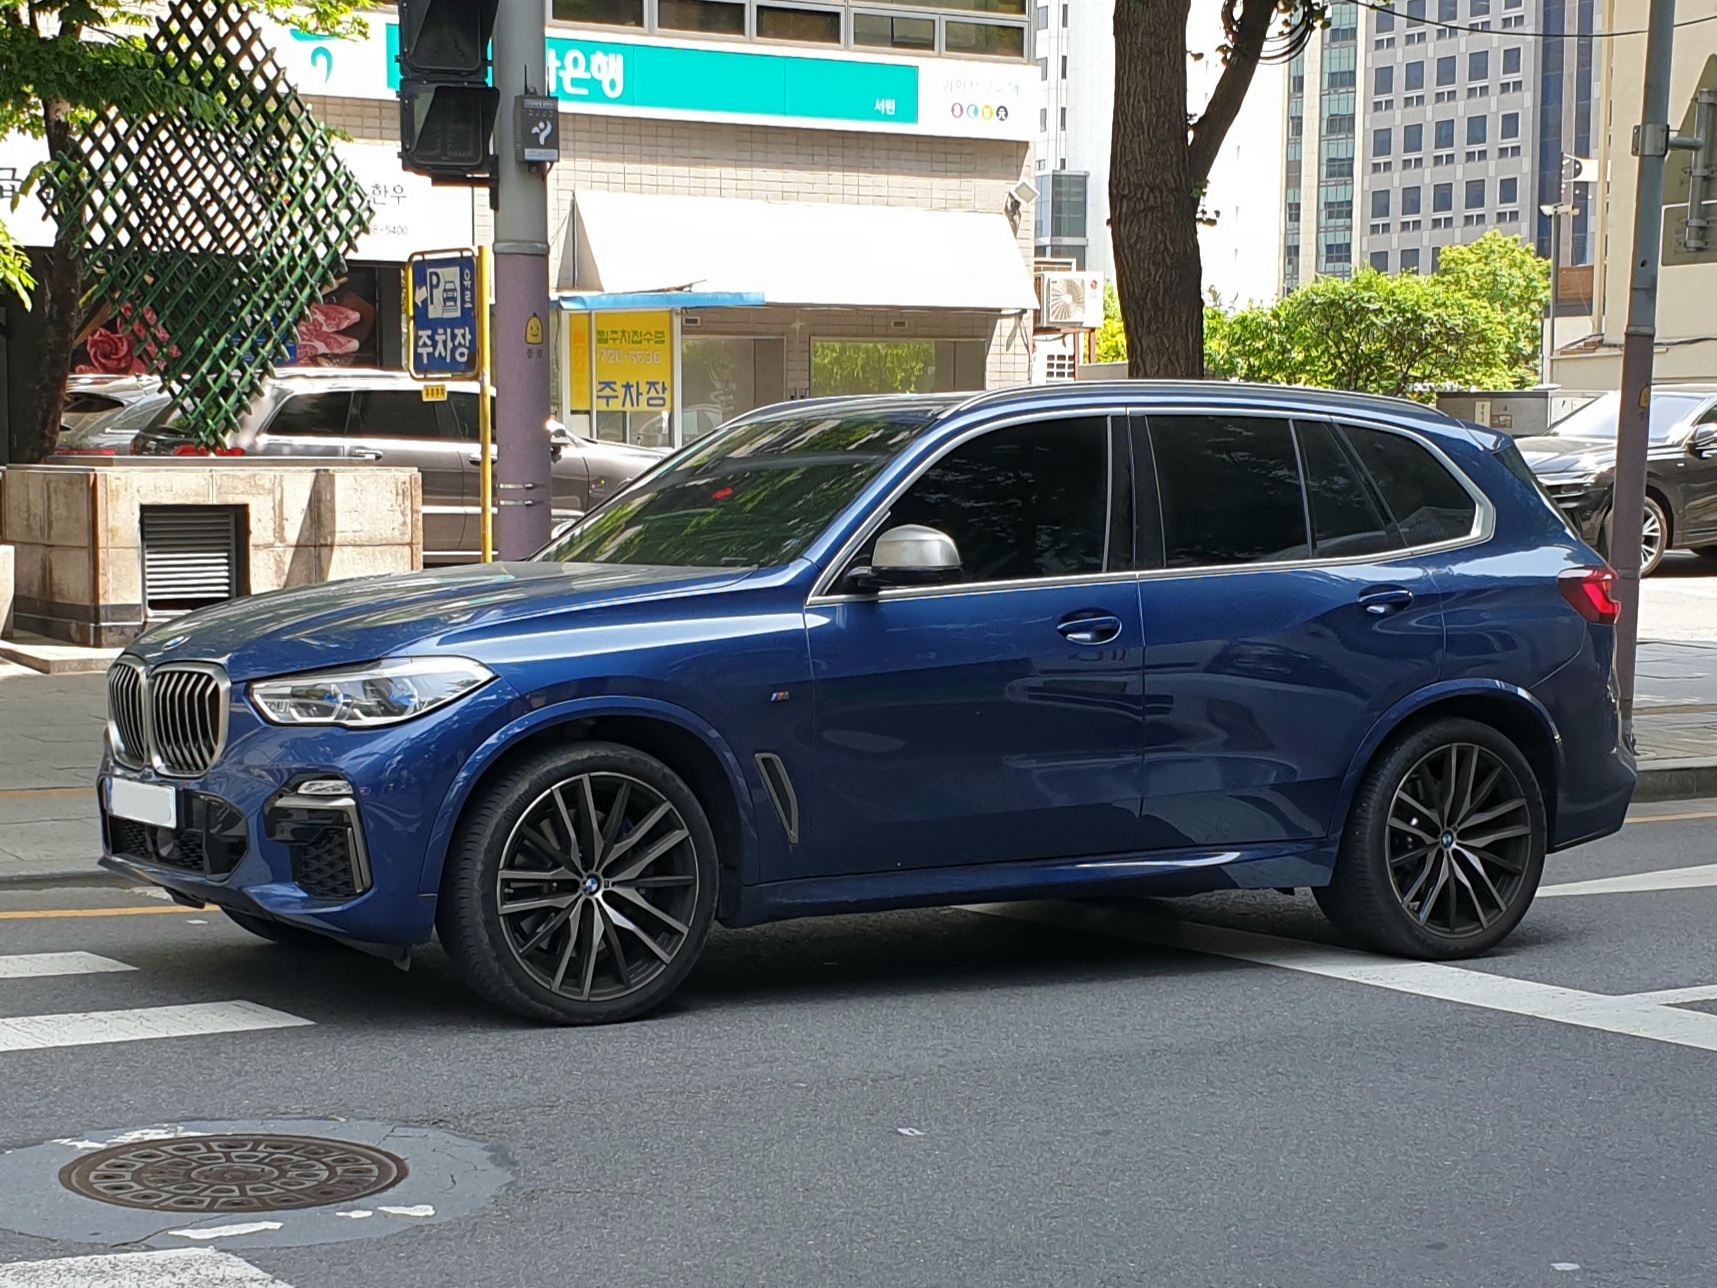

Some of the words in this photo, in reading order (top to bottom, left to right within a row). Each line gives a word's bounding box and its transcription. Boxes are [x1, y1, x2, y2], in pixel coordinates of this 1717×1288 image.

[371, 183, 407, 205] 한우
[428, 271, 441, 306] P
[463, 268, 473, 308] 유료
[417, 326, 472, 365] 주차장
[597, 381, 668, 407] 주차장
